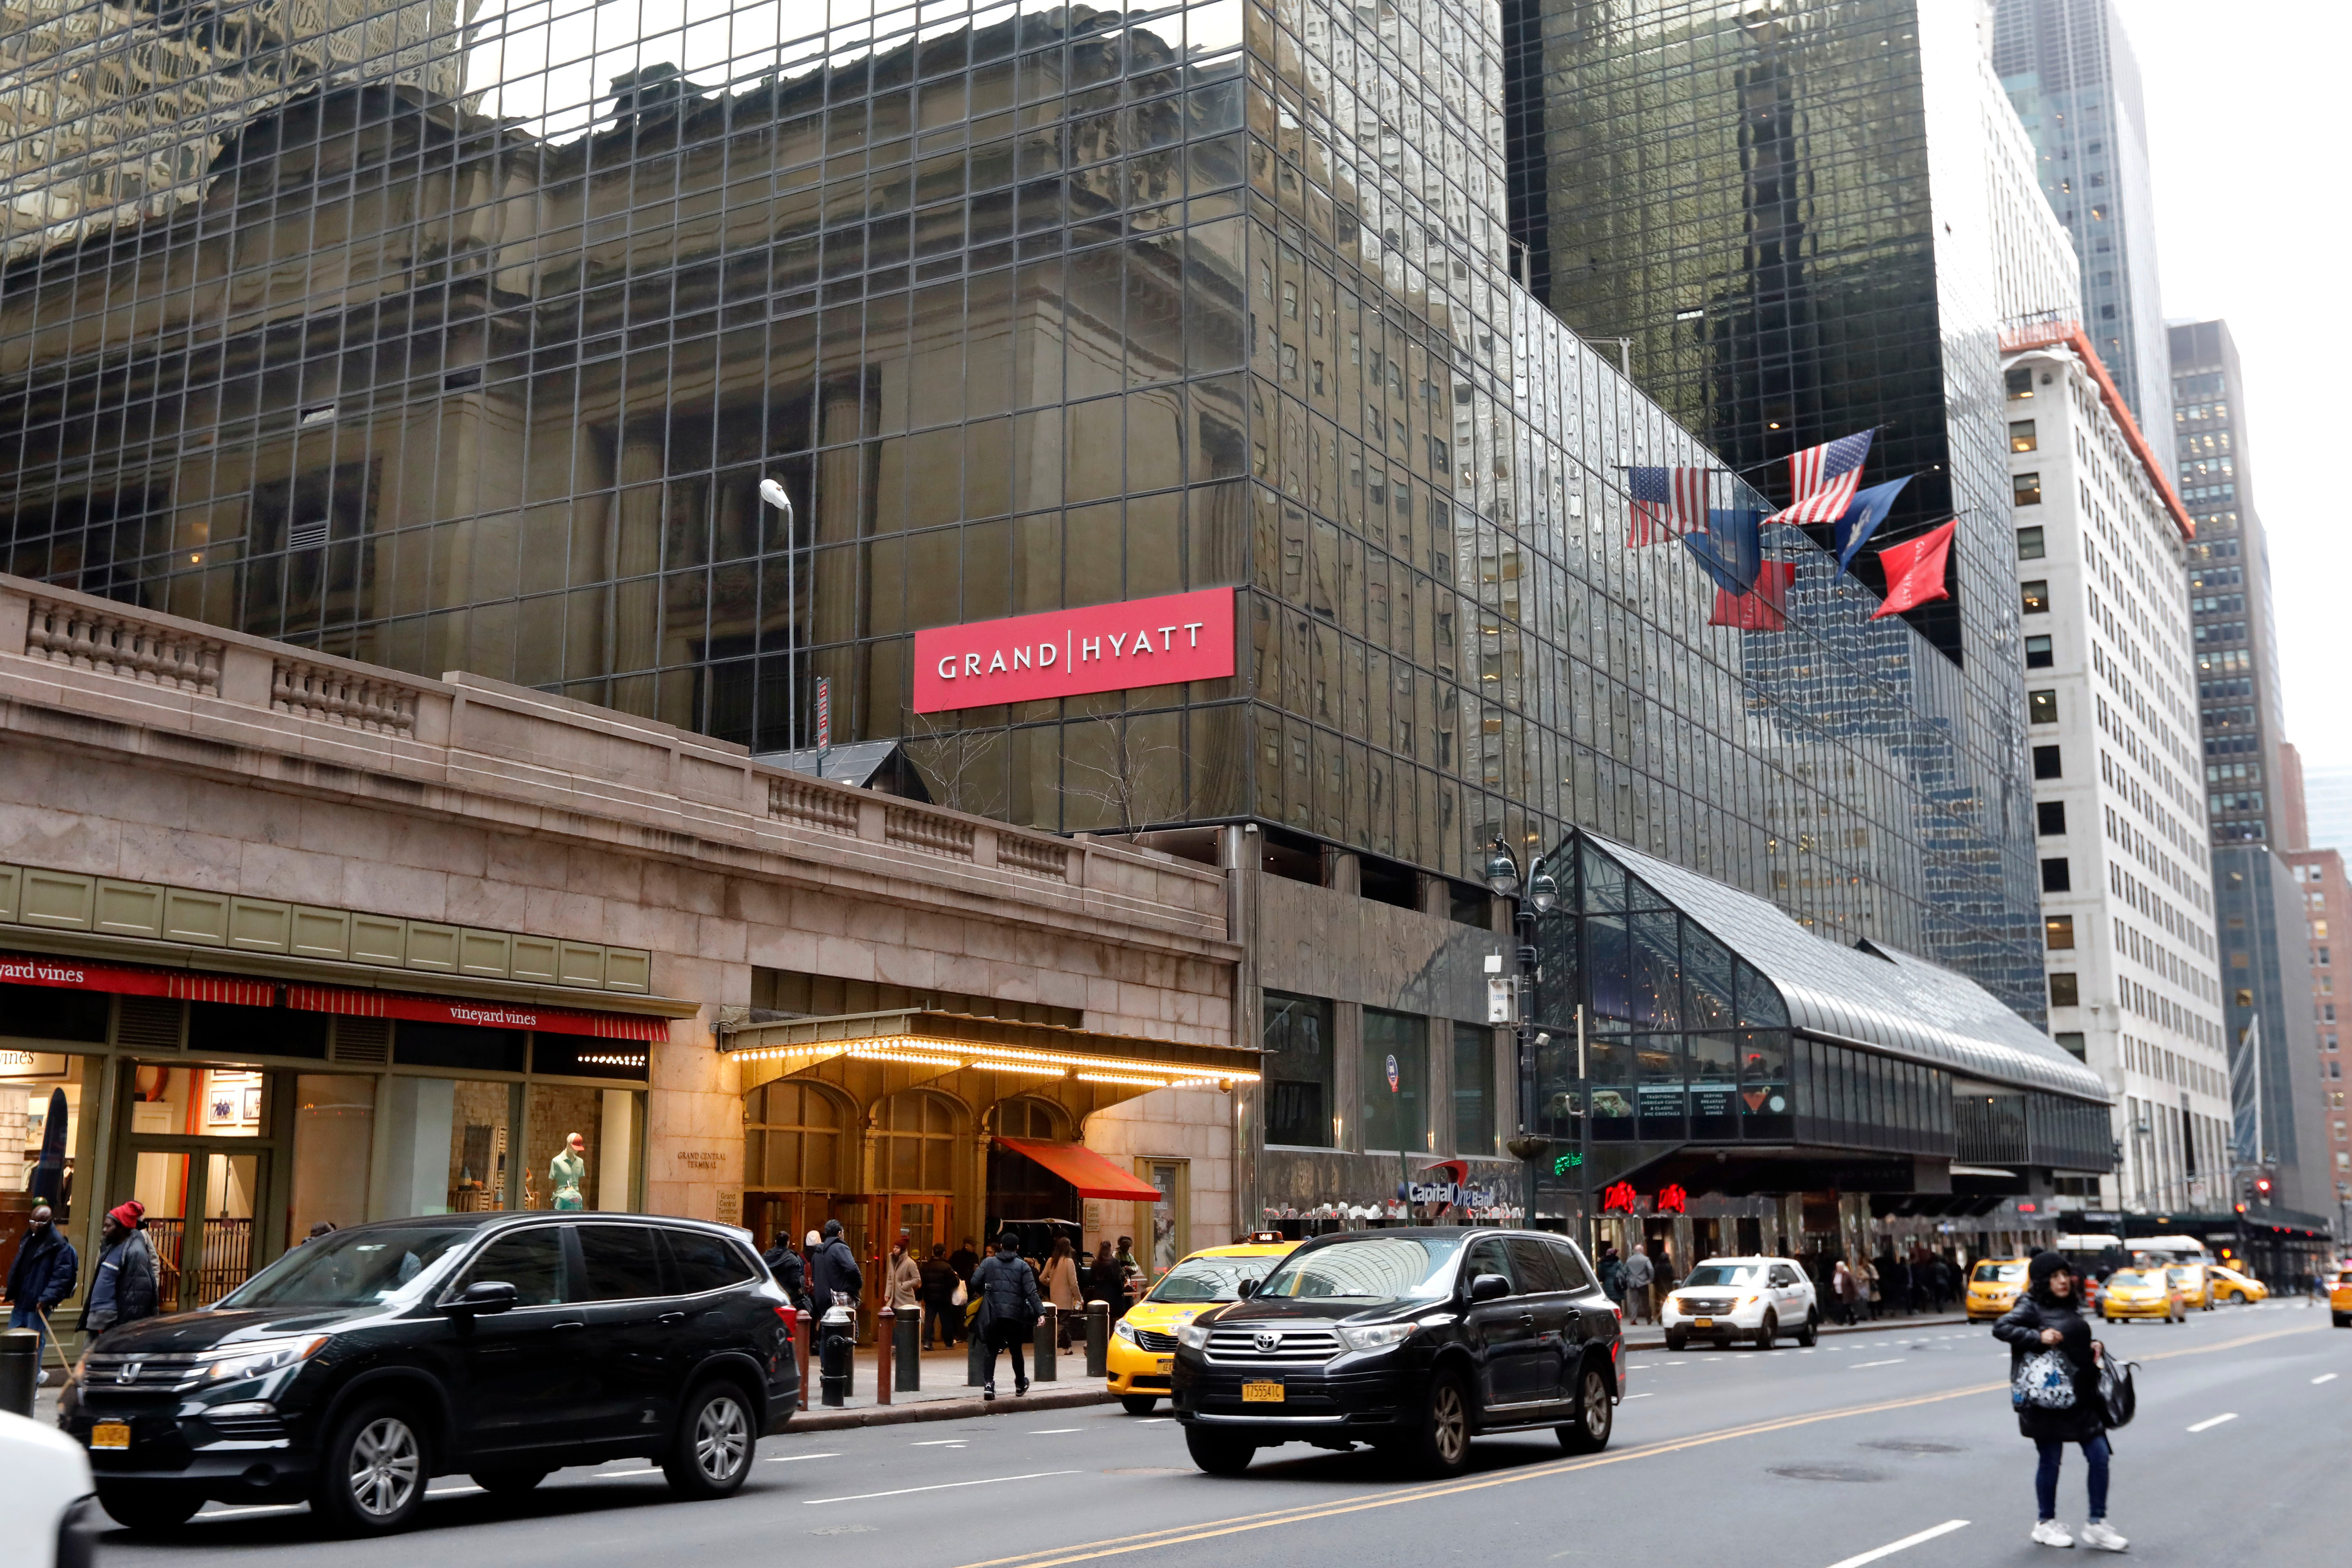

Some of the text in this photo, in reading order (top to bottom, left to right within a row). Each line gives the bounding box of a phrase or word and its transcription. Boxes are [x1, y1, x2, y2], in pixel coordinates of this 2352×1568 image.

[938, 622, 1203, 679] GRAND HYATT
[37, 964, 84, 982] vines
[450, 1005, 536, 1025] vineyard vines
[677, 1152, 699, 1160] GRAND
[687, 1160, 717, 1169] TERMINAL
[1409, 1183, 1494, 1207] Capital One Bank
[1245, 1385, 1280, 1397] T755541C
